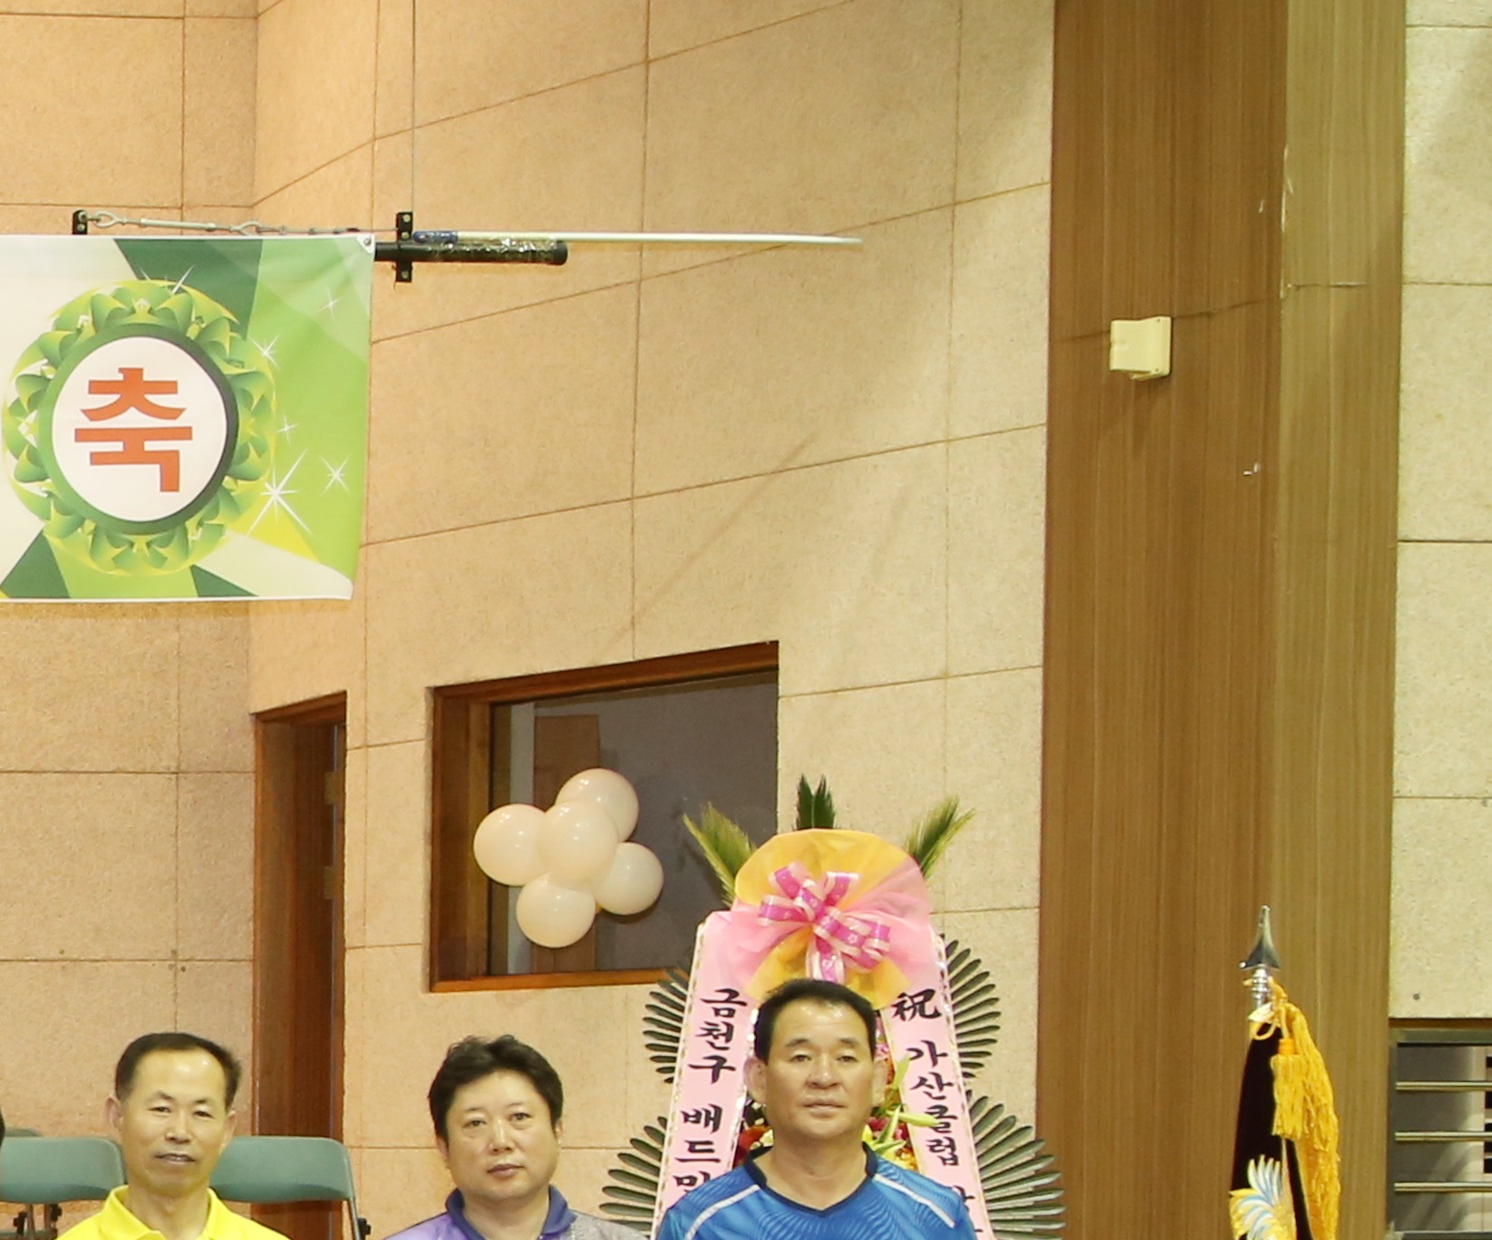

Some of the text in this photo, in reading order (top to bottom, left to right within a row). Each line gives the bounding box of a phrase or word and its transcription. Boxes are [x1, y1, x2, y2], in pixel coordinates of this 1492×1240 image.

[73, 366, 193, 493] 축
[688, 987, 748, 1084] 금천구
[892, 988, 942, 1021] 祝
[905, 1040, 960, 1167] 가산클럽
